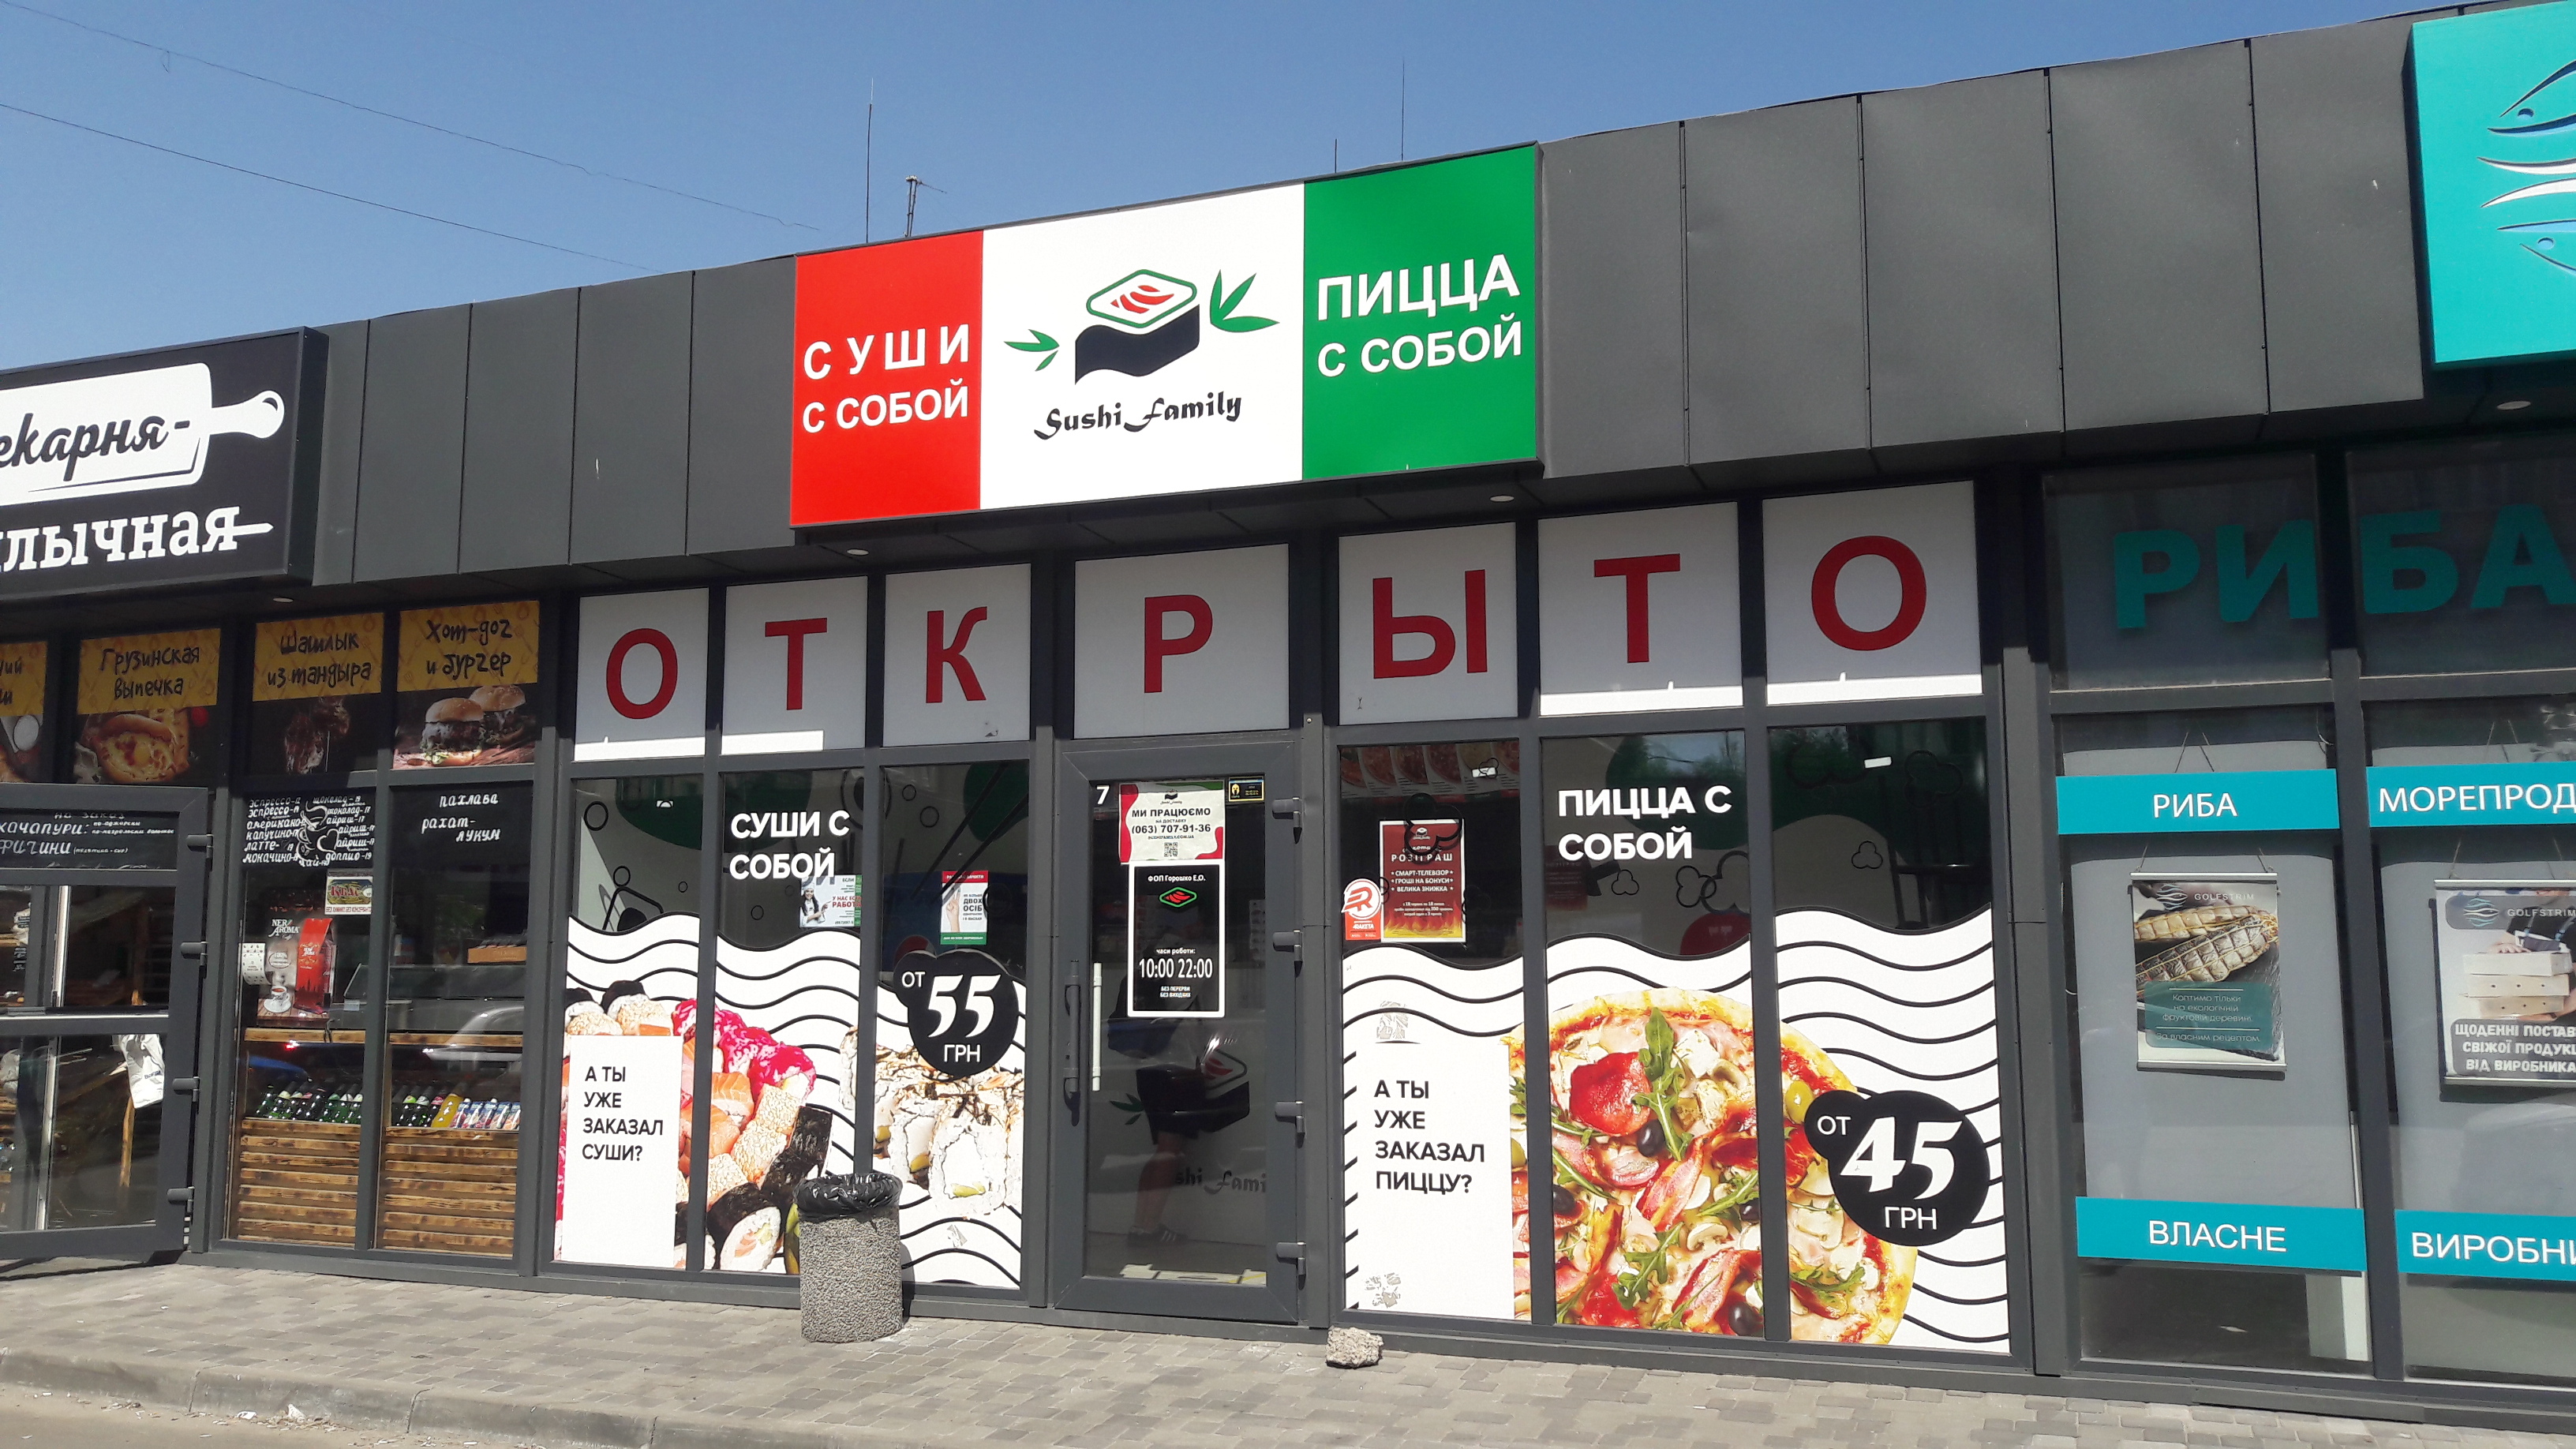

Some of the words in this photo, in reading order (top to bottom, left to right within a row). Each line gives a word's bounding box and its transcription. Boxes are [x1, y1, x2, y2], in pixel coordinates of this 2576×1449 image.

[1317, 254, 1520, 321] ПИЦЦА
[803, 324, 969, 380] СУШИ
[1316, 343, 1346, 378] С
[1359, 313, 1522, 373] СОБОЙ
[803, 401, 826, 433] С
[835, 378, 968, 429] СОБОЙ
[1034, 401, 1122, 440] Sushi
[1123, 391, 1242, 432] Family
[0, 506, 239, 572] лычная
[2114, 503, 2576, 629] РИБА
[99, 646, 200, 675] Грузинская
[426, 660, 436, 675] и
[268, 669, 285, 687] из
[290, 661, 372, 688] тандыра
[1095, 785, 1110, 804] 7
[1558, 787, 1695, 819] ПИЦЦА
[1705, 785, 1732, 814] С
[2153, 792, 2237, 818] РИБА
[2379, 783, 2576, 814] МОРЕПРОД
[1132, 809, 1147, 818] МИ
[1150, 807, 1211, 818] ПРАЦЮЄМО
[730, 811, 822, 839] СУШИ
[829, 810, 850, 836] С
[1132, 826, 1157, 834] (063)
[1160, 824, 1211, 833] 707-91-36
[1558, 826, 1692, 862] СОБОЙ
[729, 847, 835, 880] СОБОЙ
[1165, 874, 1193, 883] Горошко
[2507, 908, 2576, 918] GOLFSTRIM
[1139, 958, 1174, 979] 10:00
[1178, 958, 1213, 979] 22:00
[927, 975, 1001, 1038] 55
[2173, 994, 2212, 1002] Коптимо
[2162, 1013, 2207, 1023] фруктовій
[2455, 1024, 2519, 1037] ЩОДЕННІ
[944, 1044, 980, 1063] ГРН
[2462, 1039, 2511, 1054] СВІЖОЇ
[585, 1066, 597, 1081] А
[602, 1066, 626, 1082] ТЫ
[2466, 1059, 2491, 1072] ВІД
[2495, 1060, 2576, 1073] ВИРОБНИКА
[583, 1092, 622, 1109] УЖЕ
[1374, 1080, 1391, 1098] А
[1396, 1080, 1429, 1099] ТЫ
[582, 1118, 664, 1136] ЗАКАЗАЛ
[1374, 1110, 1425, 1129] УЖЕ
[1817, 1116, 1851, 1136] ОТ
[582, 1144, 642, 1162] СУШИ?
[1375, 1140, 1485, 1163] ЗАКАЗАЛ
[1840, 1116, 1963, 1200] 45
[1376, 1170, 1472, 1195] ПИЦЦУ?
[1885, 1206, 1937, 1230] ГРН
[2147, 1220, 2286, 1252] ВЛАСНЕ
